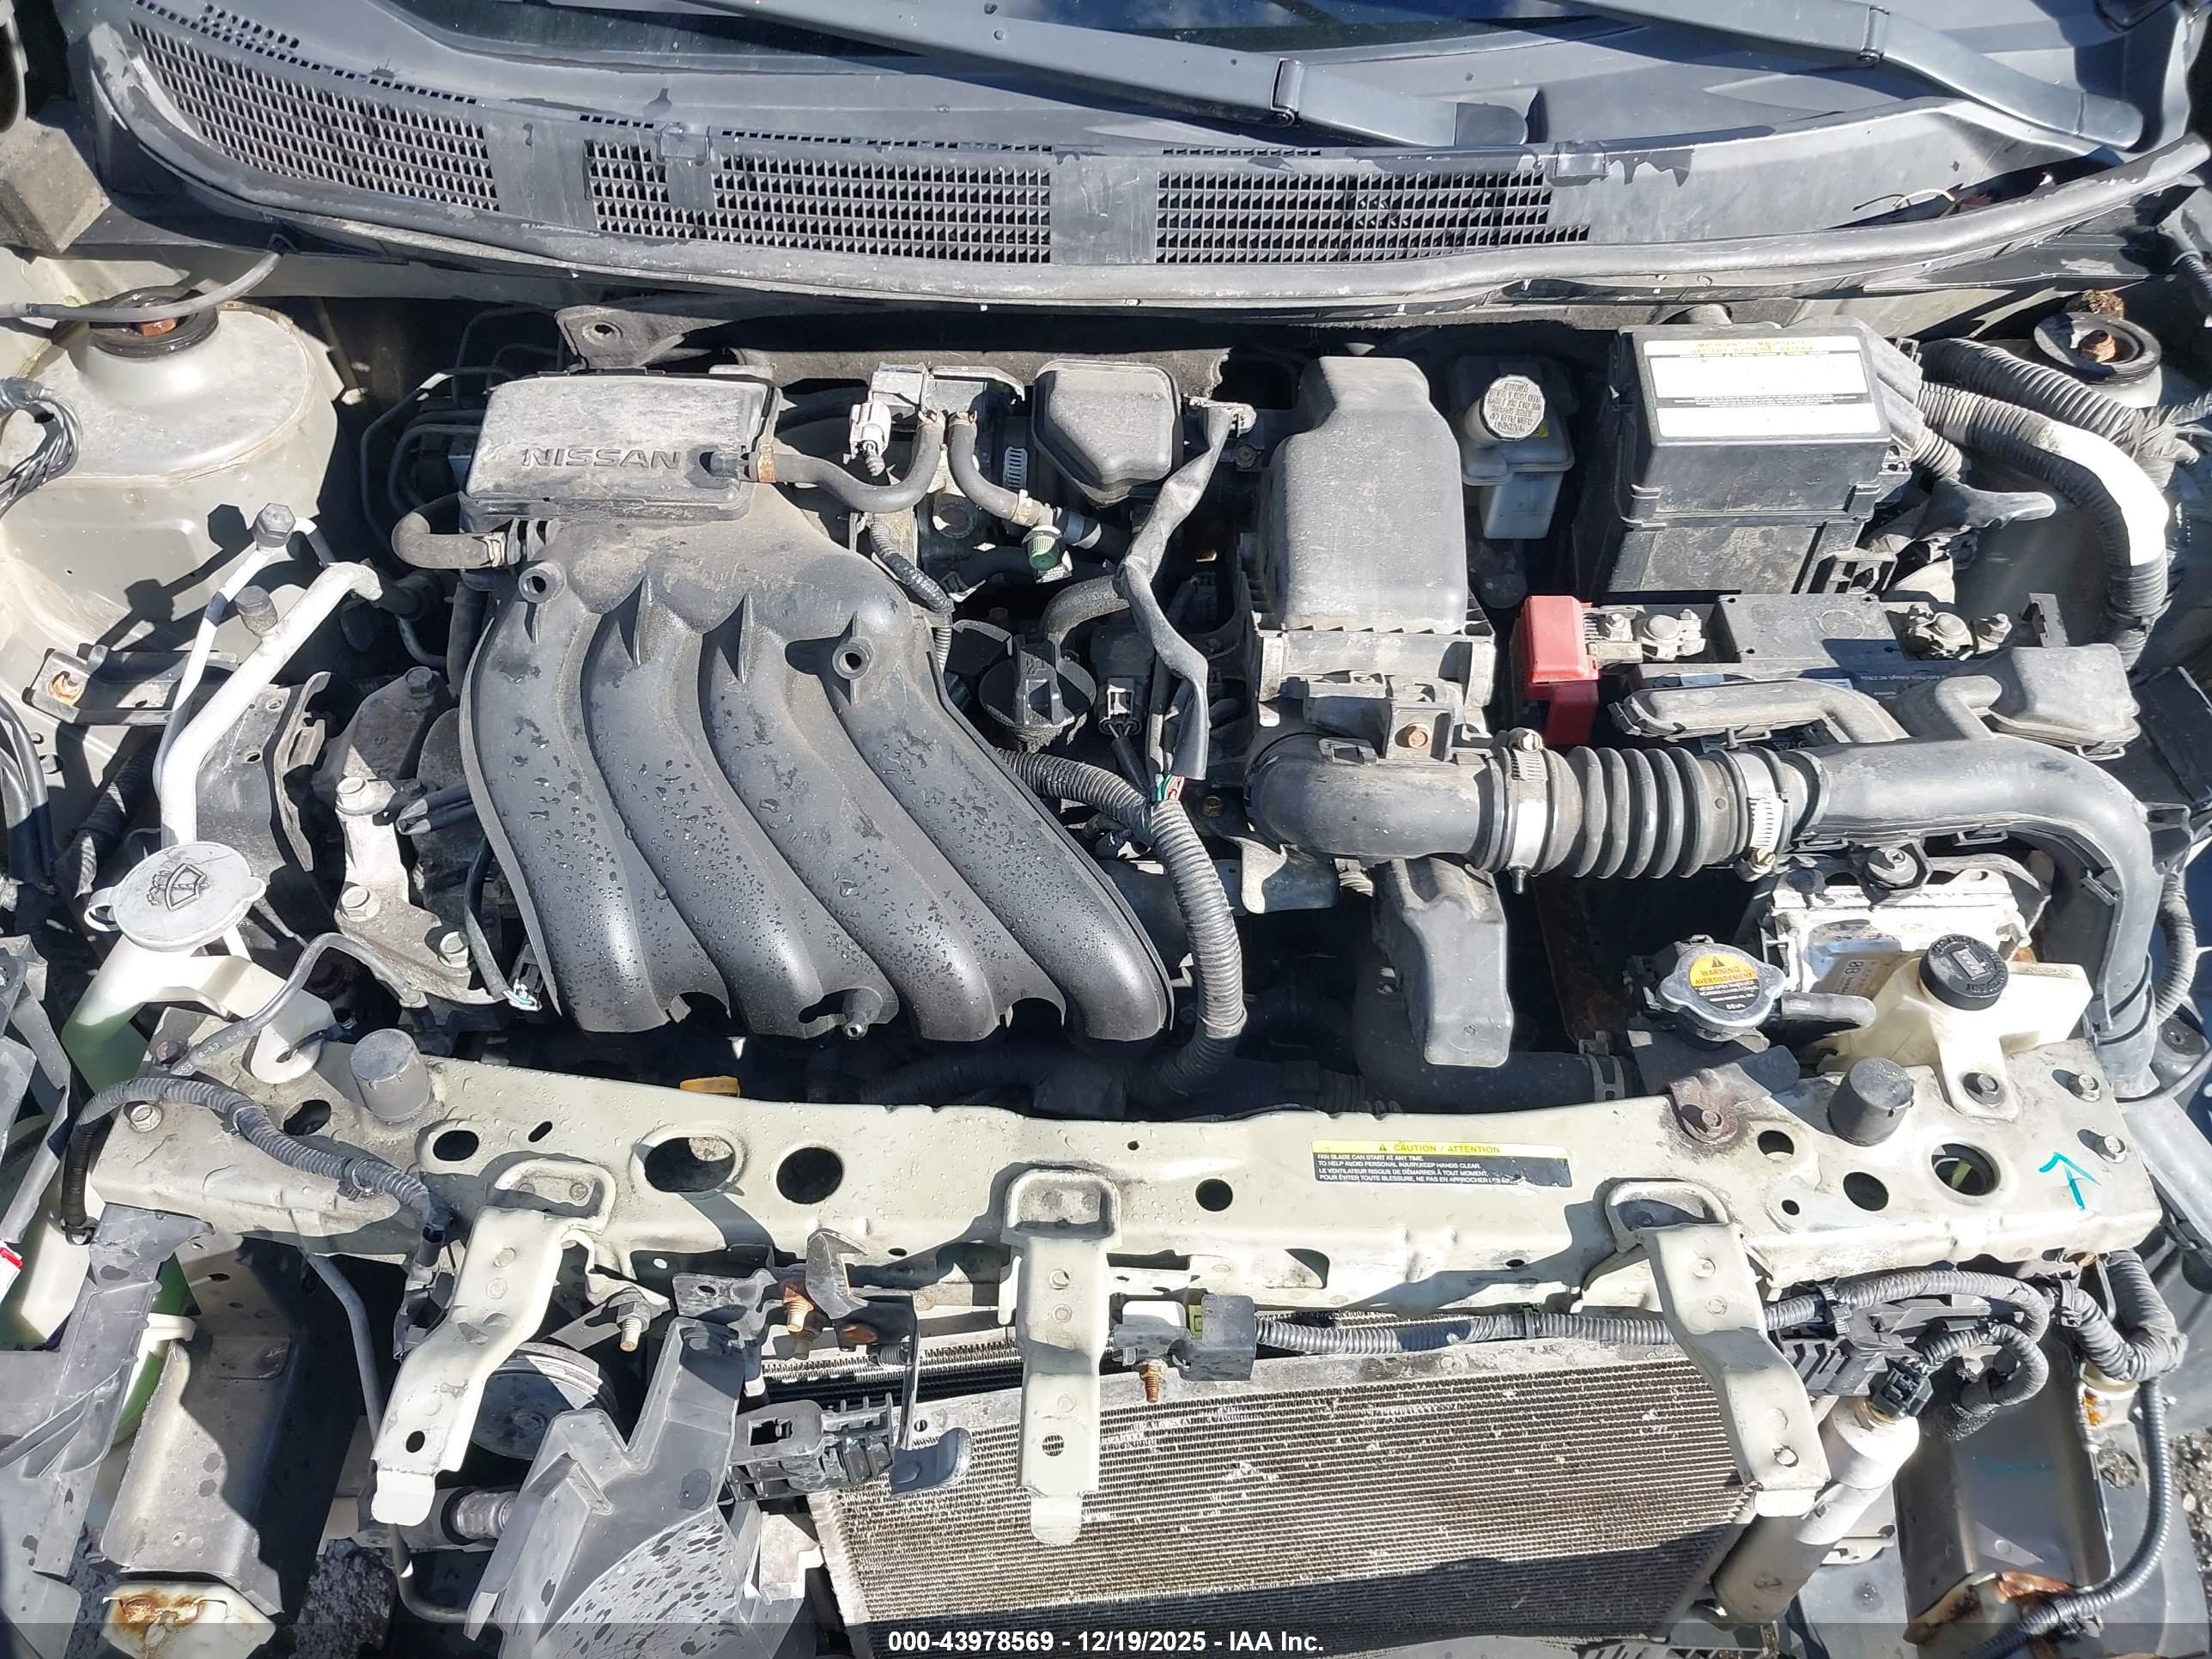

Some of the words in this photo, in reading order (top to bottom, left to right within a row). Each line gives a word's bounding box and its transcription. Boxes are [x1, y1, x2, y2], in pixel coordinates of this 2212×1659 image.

[522, 447, 682, 470] NISSAN
[1700, 966, 1741, 977] WARNING
[1695, 973, 1753, 985] AVERTISSEMENT
